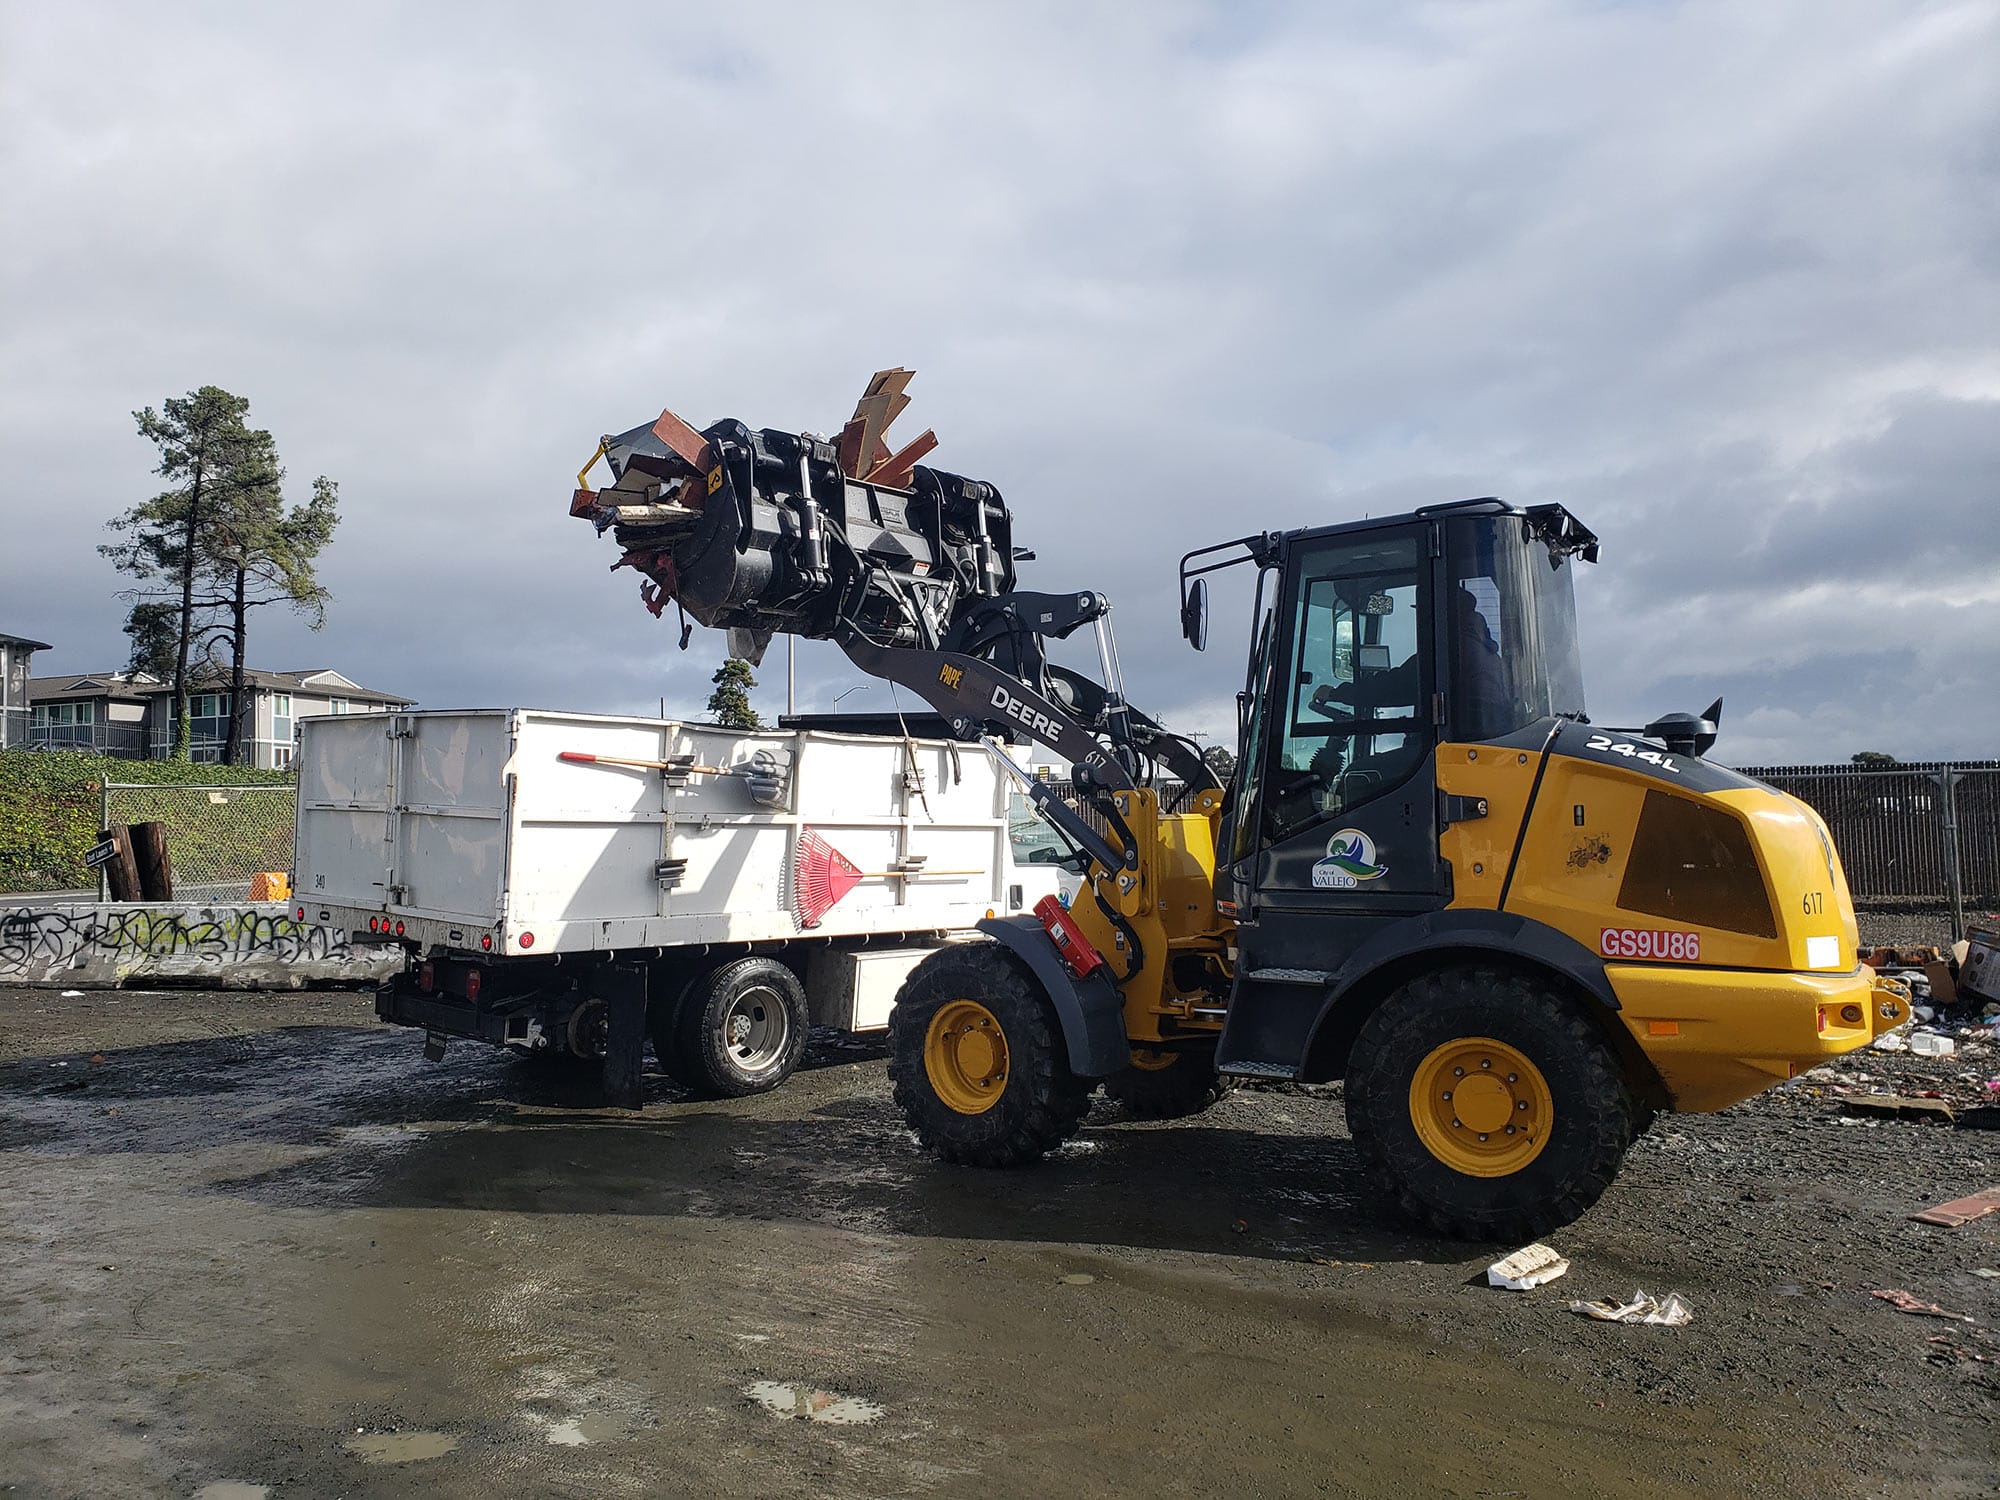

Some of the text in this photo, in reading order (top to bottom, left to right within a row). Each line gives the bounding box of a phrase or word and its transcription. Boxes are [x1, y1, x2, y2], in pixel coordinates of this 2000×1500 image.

[990, 684, 1064, 743] DEERE
[1084, 750, 1107, 768] 617
[1586, 734, 1681, 773] 244L
[315, 873, 326, 889] 340
[1313, 876, 1356, 886] VALLEJO
[1803, 892, 1823, 915] 617
[1601, 928, 1699, 960] GS9U86
